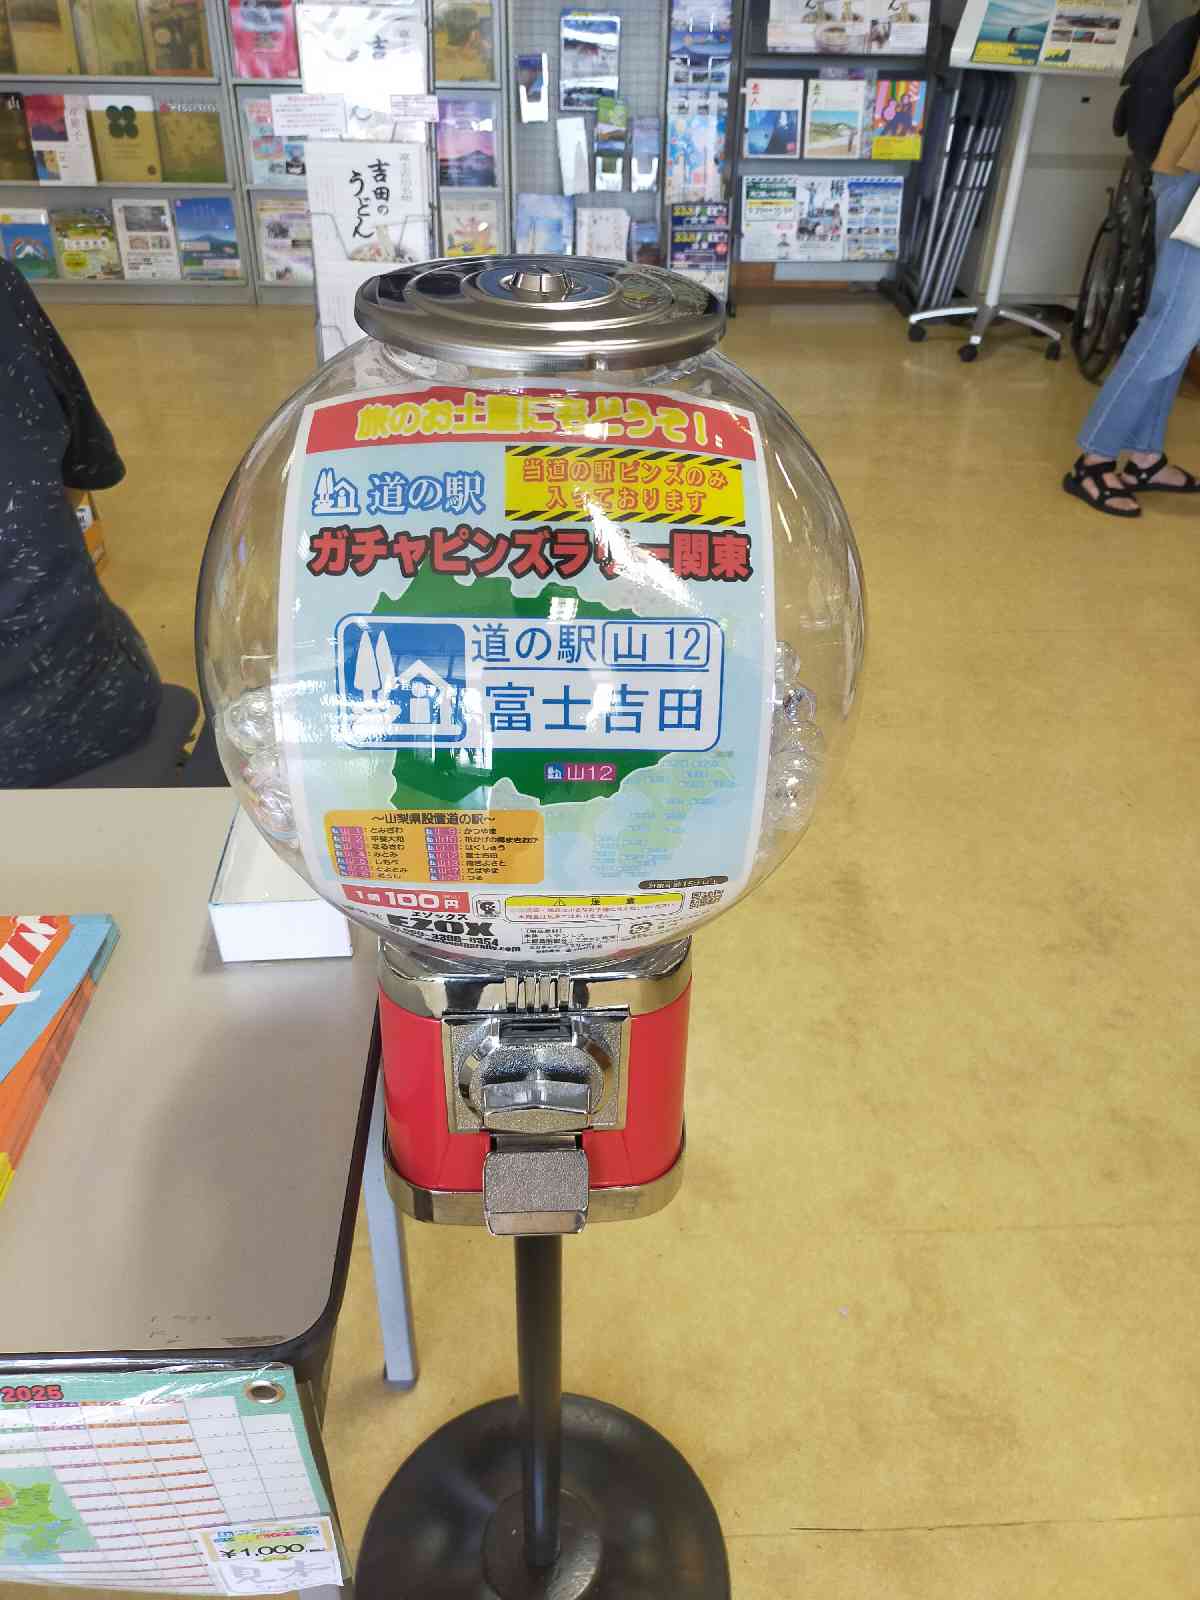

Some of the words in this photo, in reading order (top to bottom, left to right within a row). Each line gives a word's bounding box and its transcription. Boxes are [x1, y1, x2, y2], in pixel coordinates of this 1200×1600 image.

[349, 170, 374, 239] うどん
[367, 158, 390, 216] 吉田の
[367, 471, 485, 515] 道の駅
[522, 457, 730, 491] 当道の駅ピンズのみ
[470, 622, 599, 664] 道の駅
[484, 681, 702, 734] 富士吉田
[566, 765, 614, 782] 山12
[387, 913, 496, 937] EZOX
[0, 1384, 65, 1402] 2025
